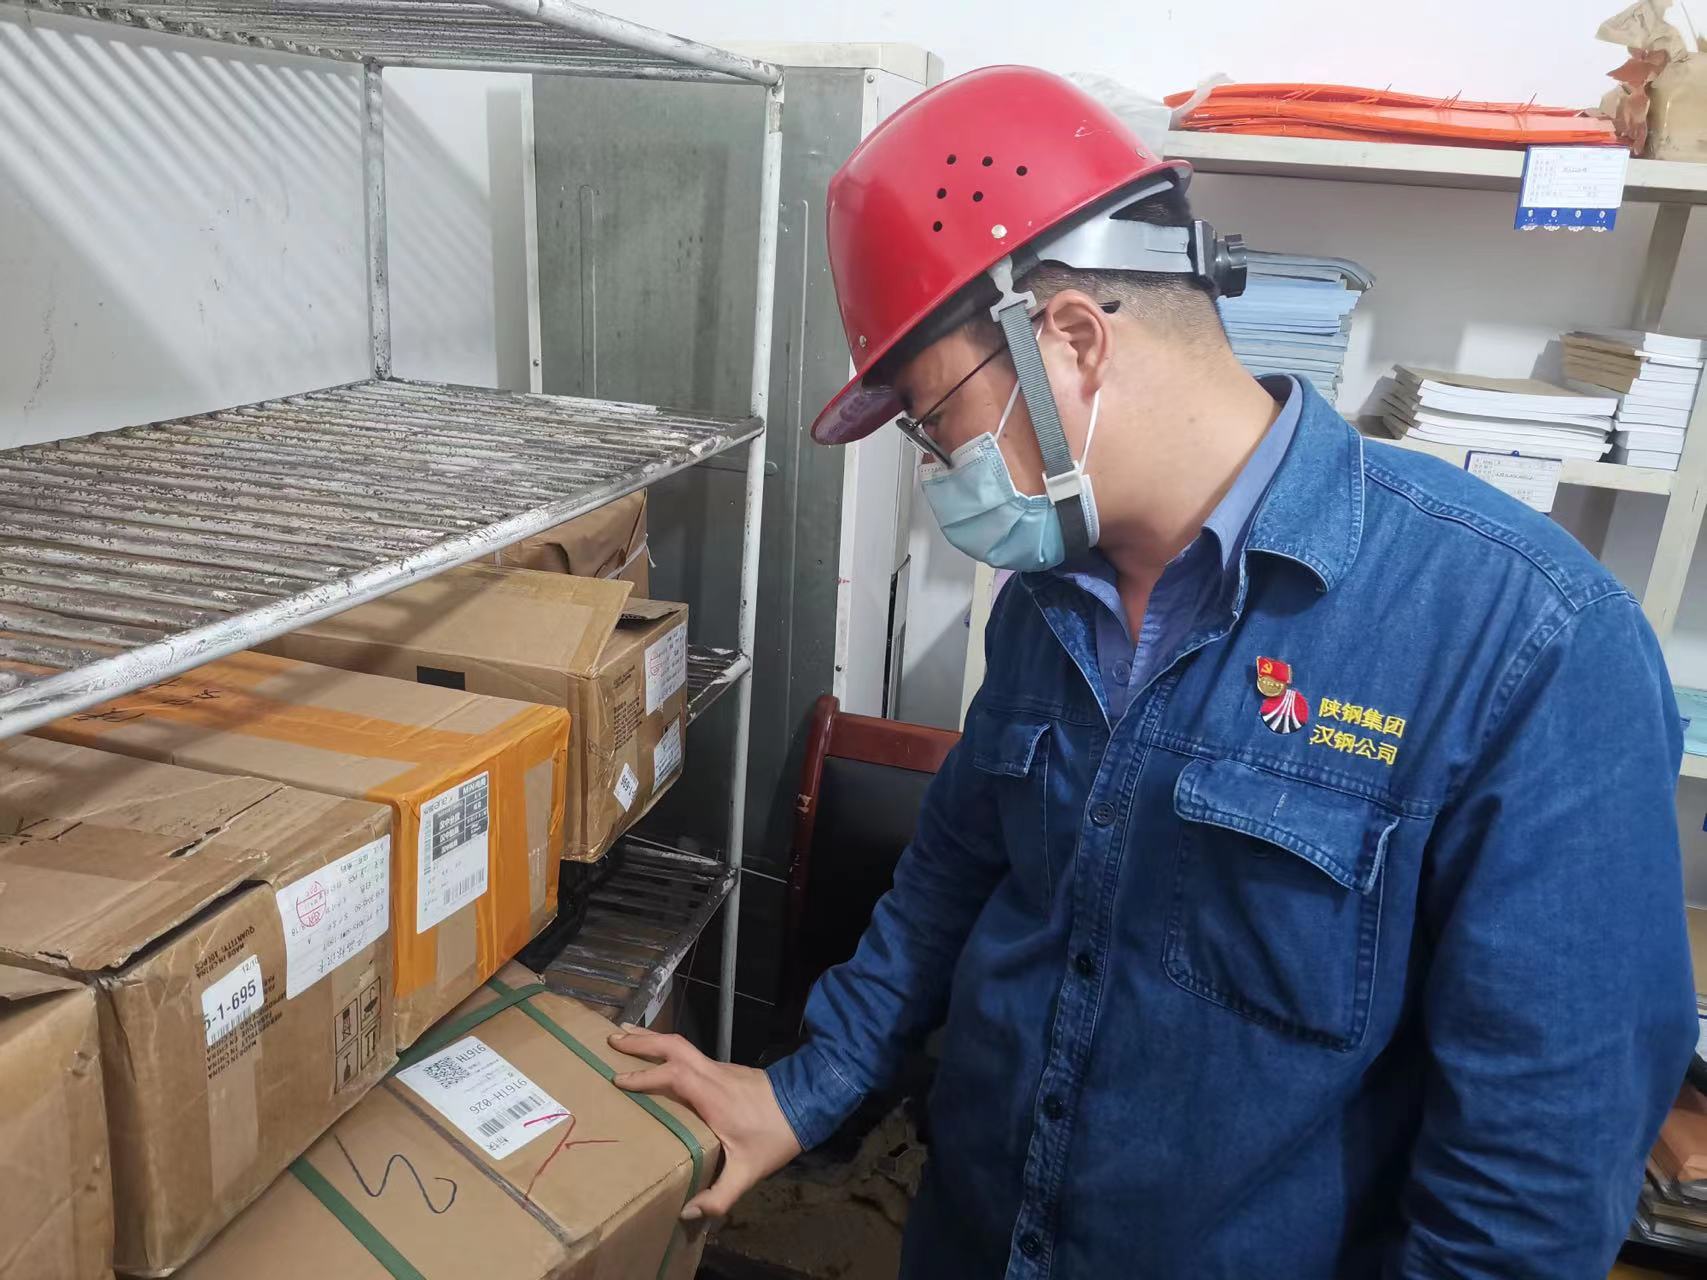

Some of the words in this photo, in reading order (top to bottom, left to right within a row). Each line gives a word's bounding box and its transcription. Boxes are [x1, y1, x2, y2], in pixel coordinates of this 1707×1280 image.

[1319, 697, 1406, 738] 陕钢集团
[1309, 724, 1398, 765] 汉钢公司
[196, 961, 218, 979] CHINA
[455, 1043, 487, 1064] 916TH
[208, 1060, 230, 1080] CHINA
